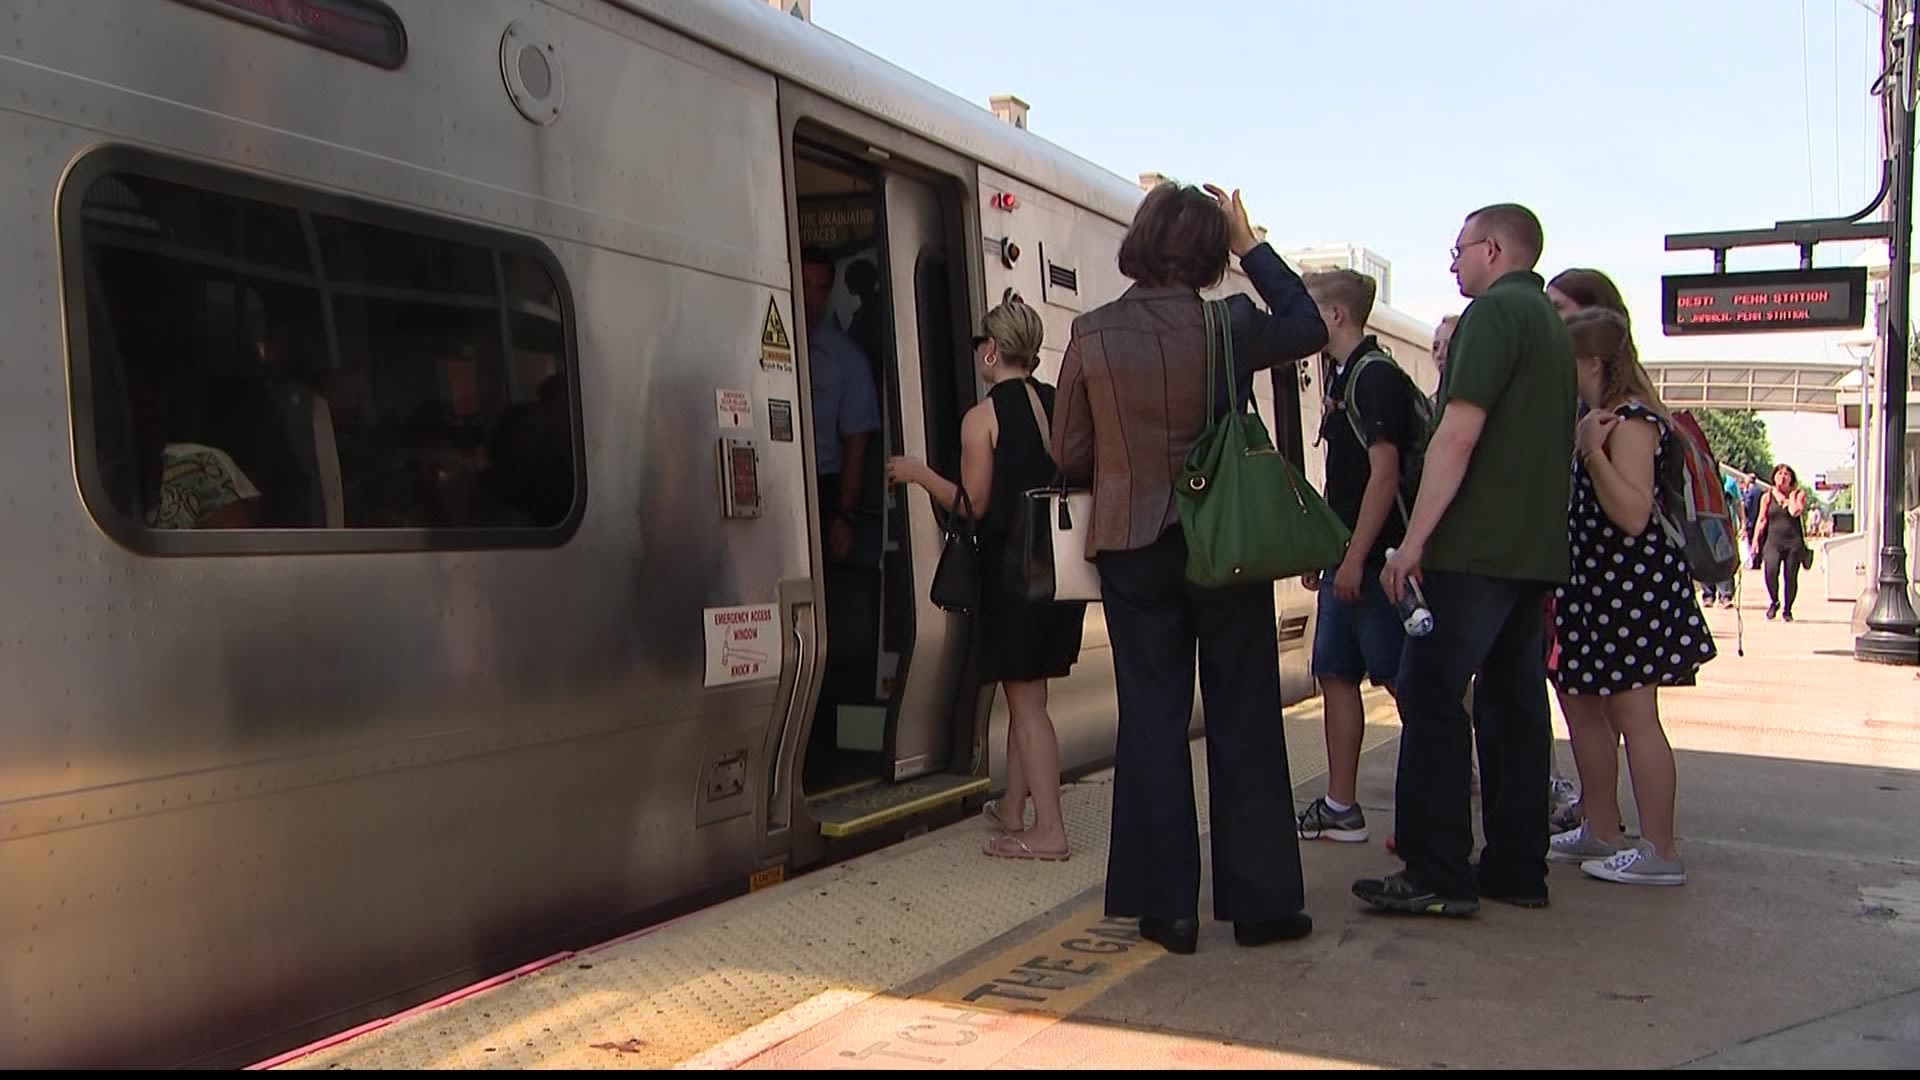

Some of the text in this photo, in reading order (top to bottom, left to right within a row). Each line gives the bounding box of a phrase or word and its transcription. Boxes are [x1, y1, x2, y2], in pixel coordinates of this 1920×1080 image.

[1734, 293, 1767, 305] PENN
[1773, 290, 1829, 304] STATION
[714, 609, 772, 626] EMERGENCY ACCESS
[961, 955, 1105, 1002] THE
[1060, 917, 1140, 955] GA
